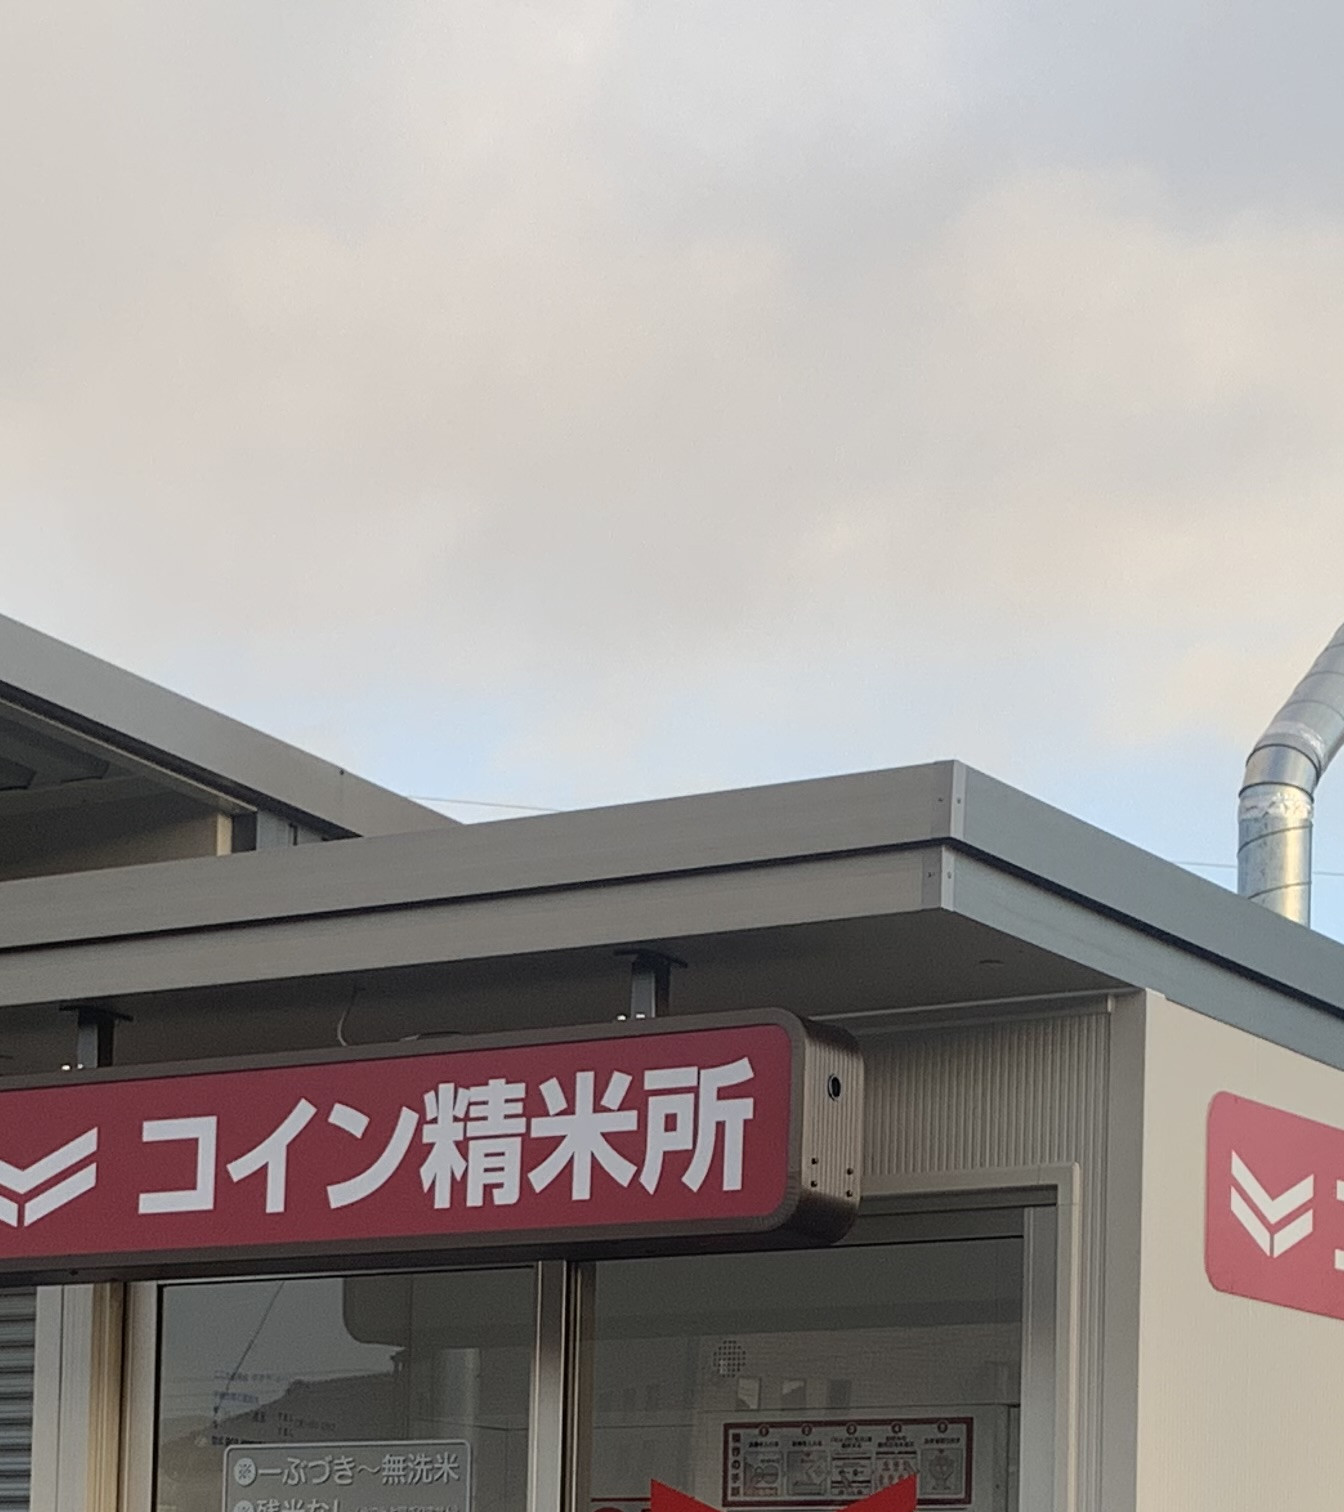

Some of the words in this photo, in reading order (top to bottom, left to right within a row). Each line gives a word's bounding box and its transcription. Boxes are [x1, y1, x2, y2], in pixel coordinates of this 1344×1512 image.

[138, 1056, 754, 1215] コイン精米所
